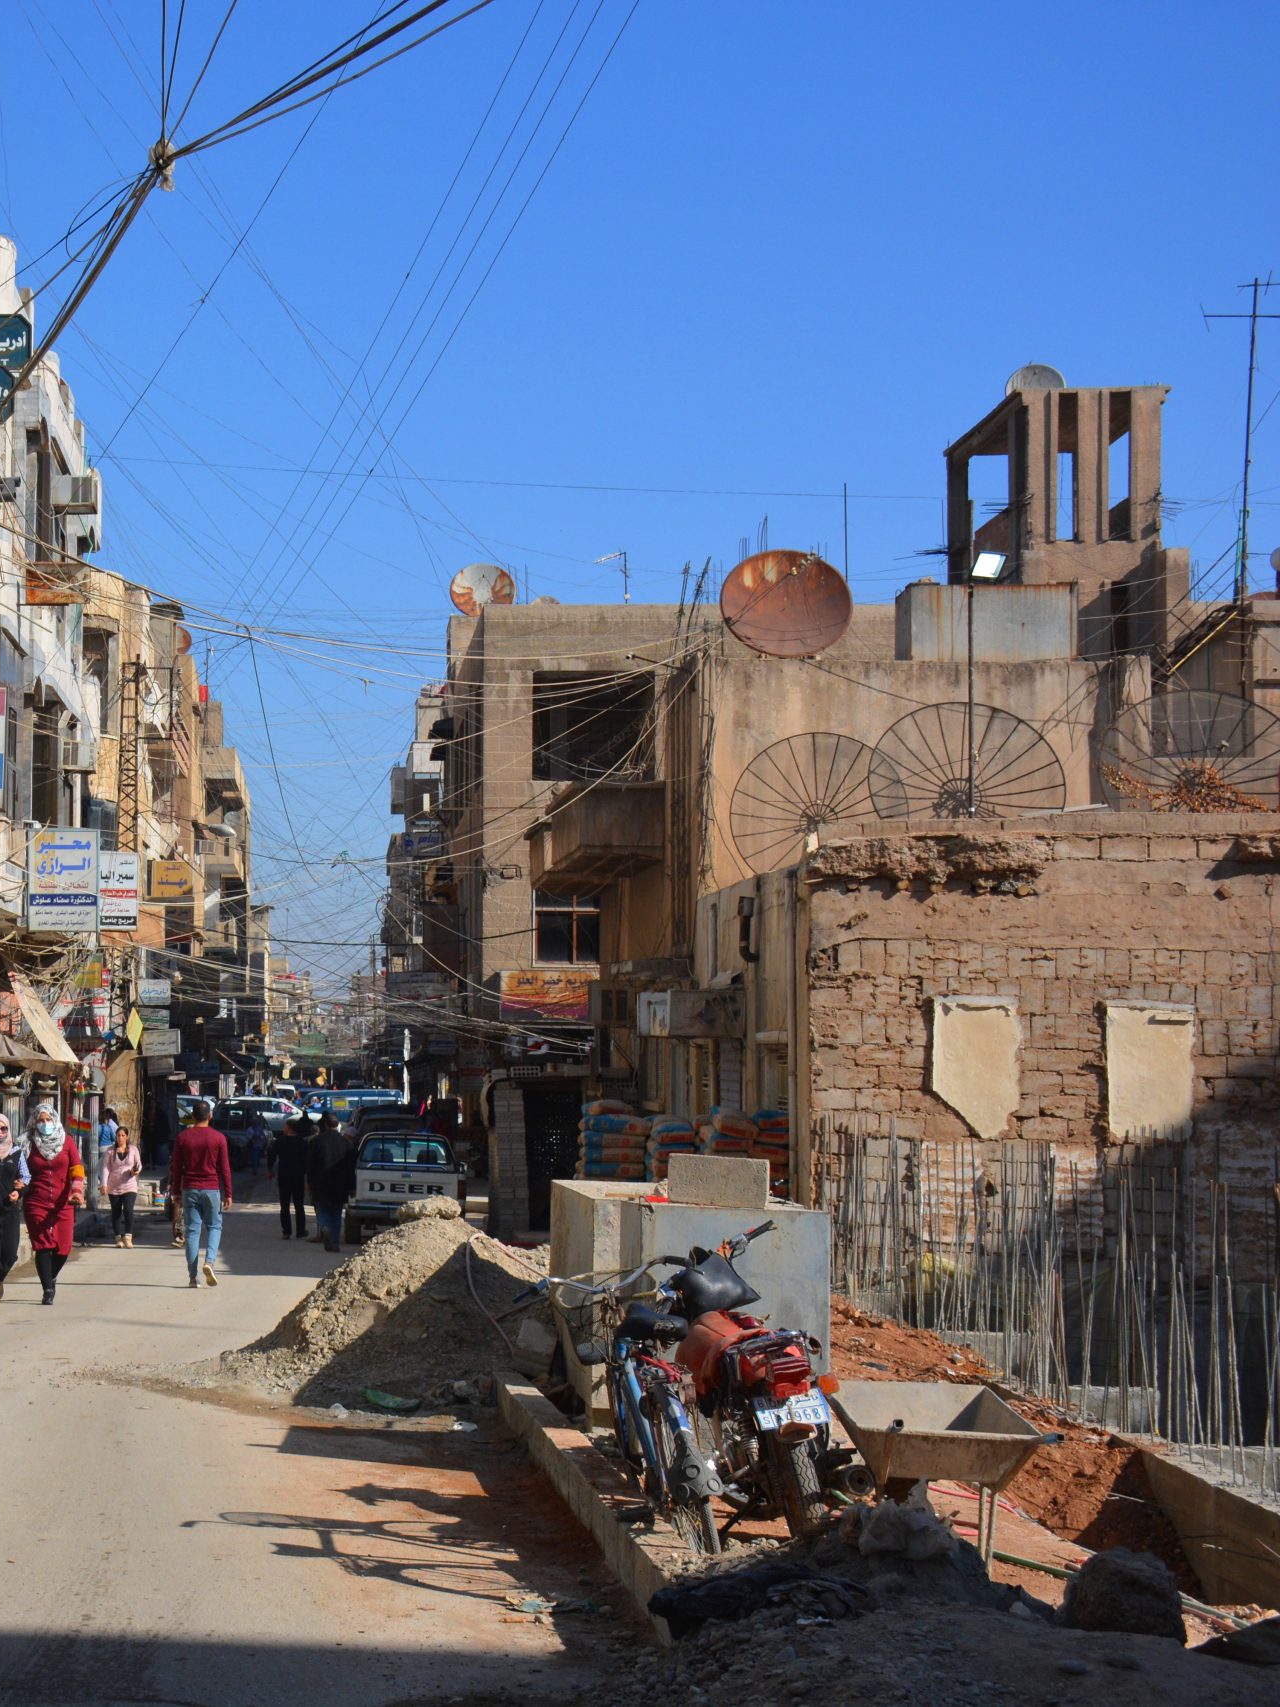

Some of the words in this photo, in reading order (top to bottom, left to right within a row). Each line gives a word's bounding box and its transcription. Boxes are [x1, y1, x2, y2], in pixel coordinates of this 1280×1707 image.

[35, 836, 91, 854] مخبر
[36, 856, 91, 879] الرازي
[116, 873, 134, 883] سمير
[368, 1181, 445, 1196] DEER
